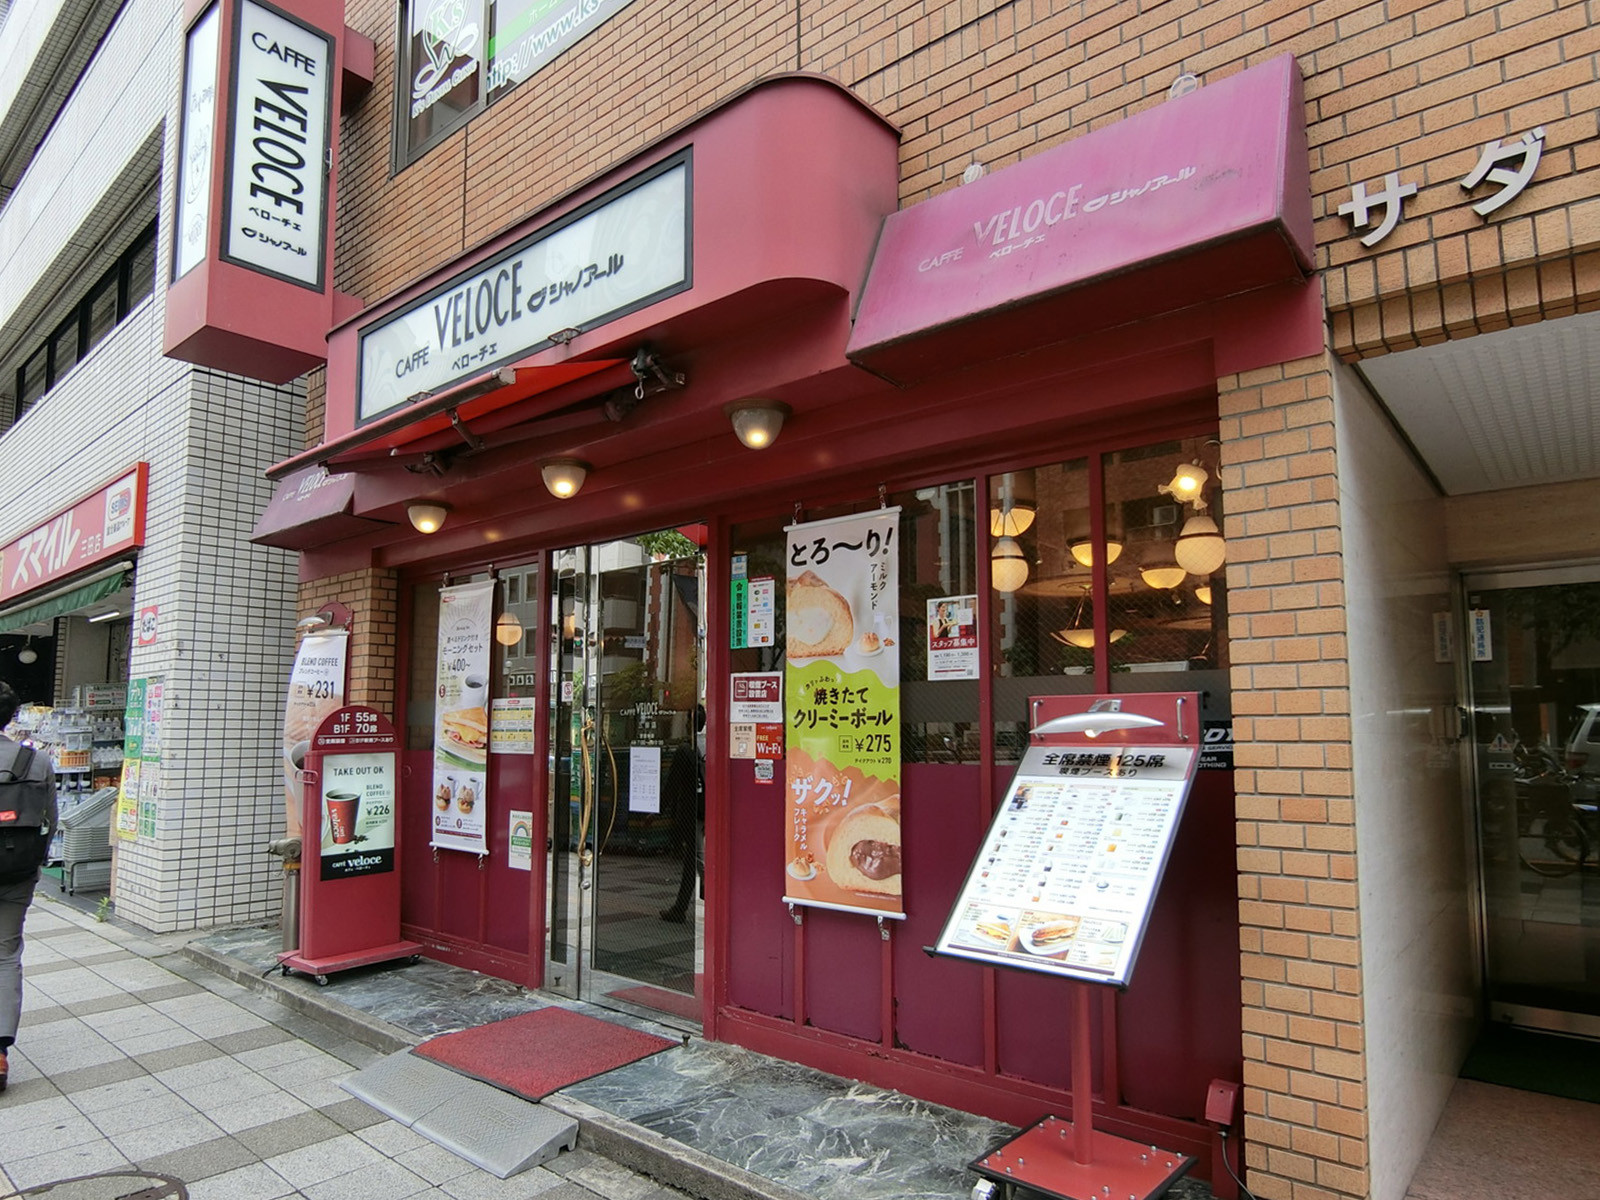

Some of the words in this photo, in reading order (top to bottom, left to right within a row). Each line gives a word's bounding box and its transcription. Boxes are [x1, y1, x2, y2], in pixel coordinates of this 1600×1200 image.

[252, 32, 316, 77] CAFFE
[250, 78, 309, 216] VELOCE
[249, 206, 302, 232] ベローチェ
[918, 247, 963, 273] CAFFE
[973, 183, 1082, 248] VELOCE
[1110, 166, 1196, 206] シャノアール
[259, 233, 308, 257] シャノアール
[989, 234, 1045, 259] ベローチェ
[396, 346, 430, 379] CAFFE
[434, 260, 523, 352] VELOCE
[550, 253, 624, 305] シャノアール
[451, 343, 498, 371] ベローチェ
[12, 509, 81, 589] スマイル
[869, 563, 879, 611] アーモンド
[878, 562, 888, 591] ミルク
[442, 643, 483, 655] モーニングセット
[318, 657, 338, 667] COFFEE
[814, 687, 869, 705] 焼きたて
[333, 724, 351, 734] B1F
[341, 713, 351, 723] 1F
[793, 707, 893, 730] クリーミーボール
[756, 742, 782, 755] Wi-Fi
[854, 734, 892, 752] ¥275
[333, 768, 354, 776] TAKE
[355, 767, 372, 775] OUT
[373, 766, 384, 774] OK
[1042, 752, 1113, 767] 全席禁煙
[1115, 753, 1166, 768] 125席
[1058, 767, 1138, 778] 喫煙ブースあり
[366, 805, 390, 816] ¥226
[800, 808, 808, 850] キャラメル
[347, 855, 382, 867] veloce
